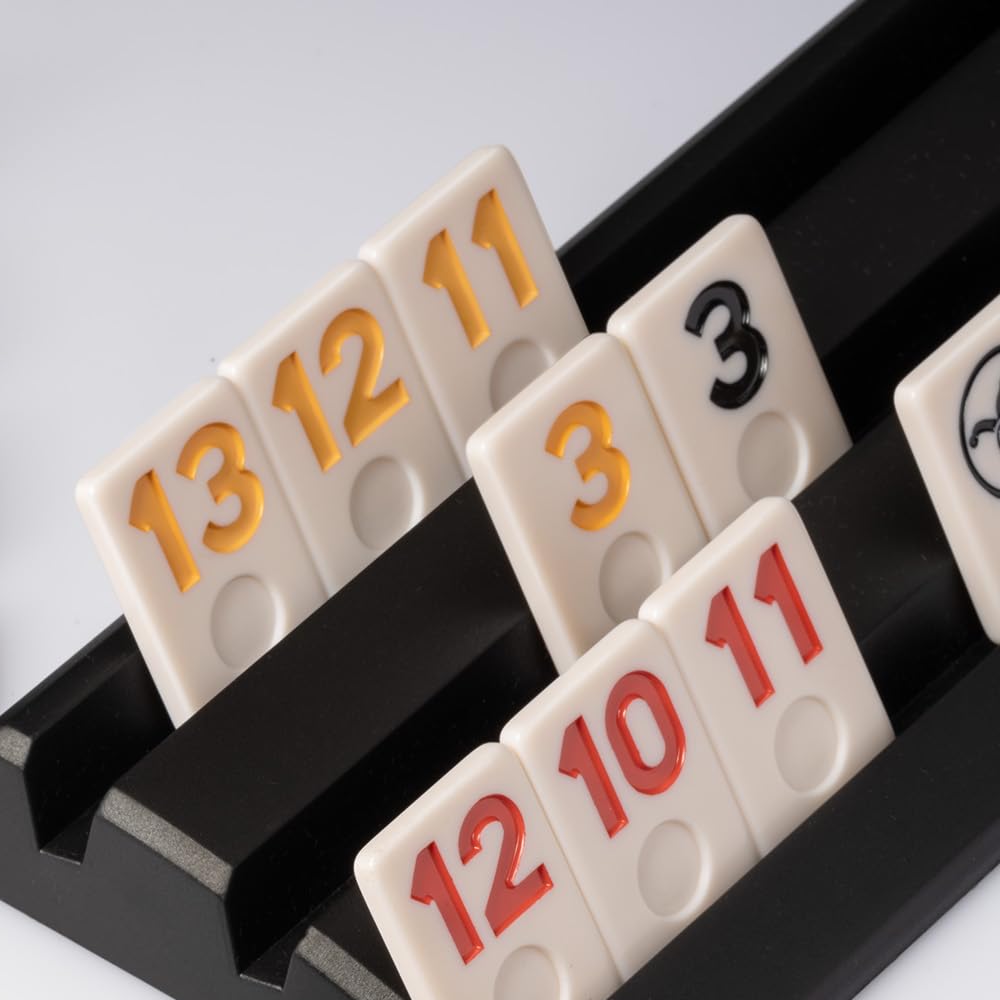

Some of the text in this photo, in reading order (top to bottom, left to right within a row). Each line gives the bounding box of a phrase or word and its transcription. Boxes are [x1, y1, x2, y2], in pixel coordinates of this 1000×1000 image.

[423, 187, 539, 350] 11
[685, 280, 768, 410] 3
[271, 307, 411, 473] 12
[544, 400, 631, 532] 3
[128, 421, 265, 593] 13
[705, 543, 824, 708] 11
[558, 670, 686, 838] 10
[410, 794, 554, 965] 12
